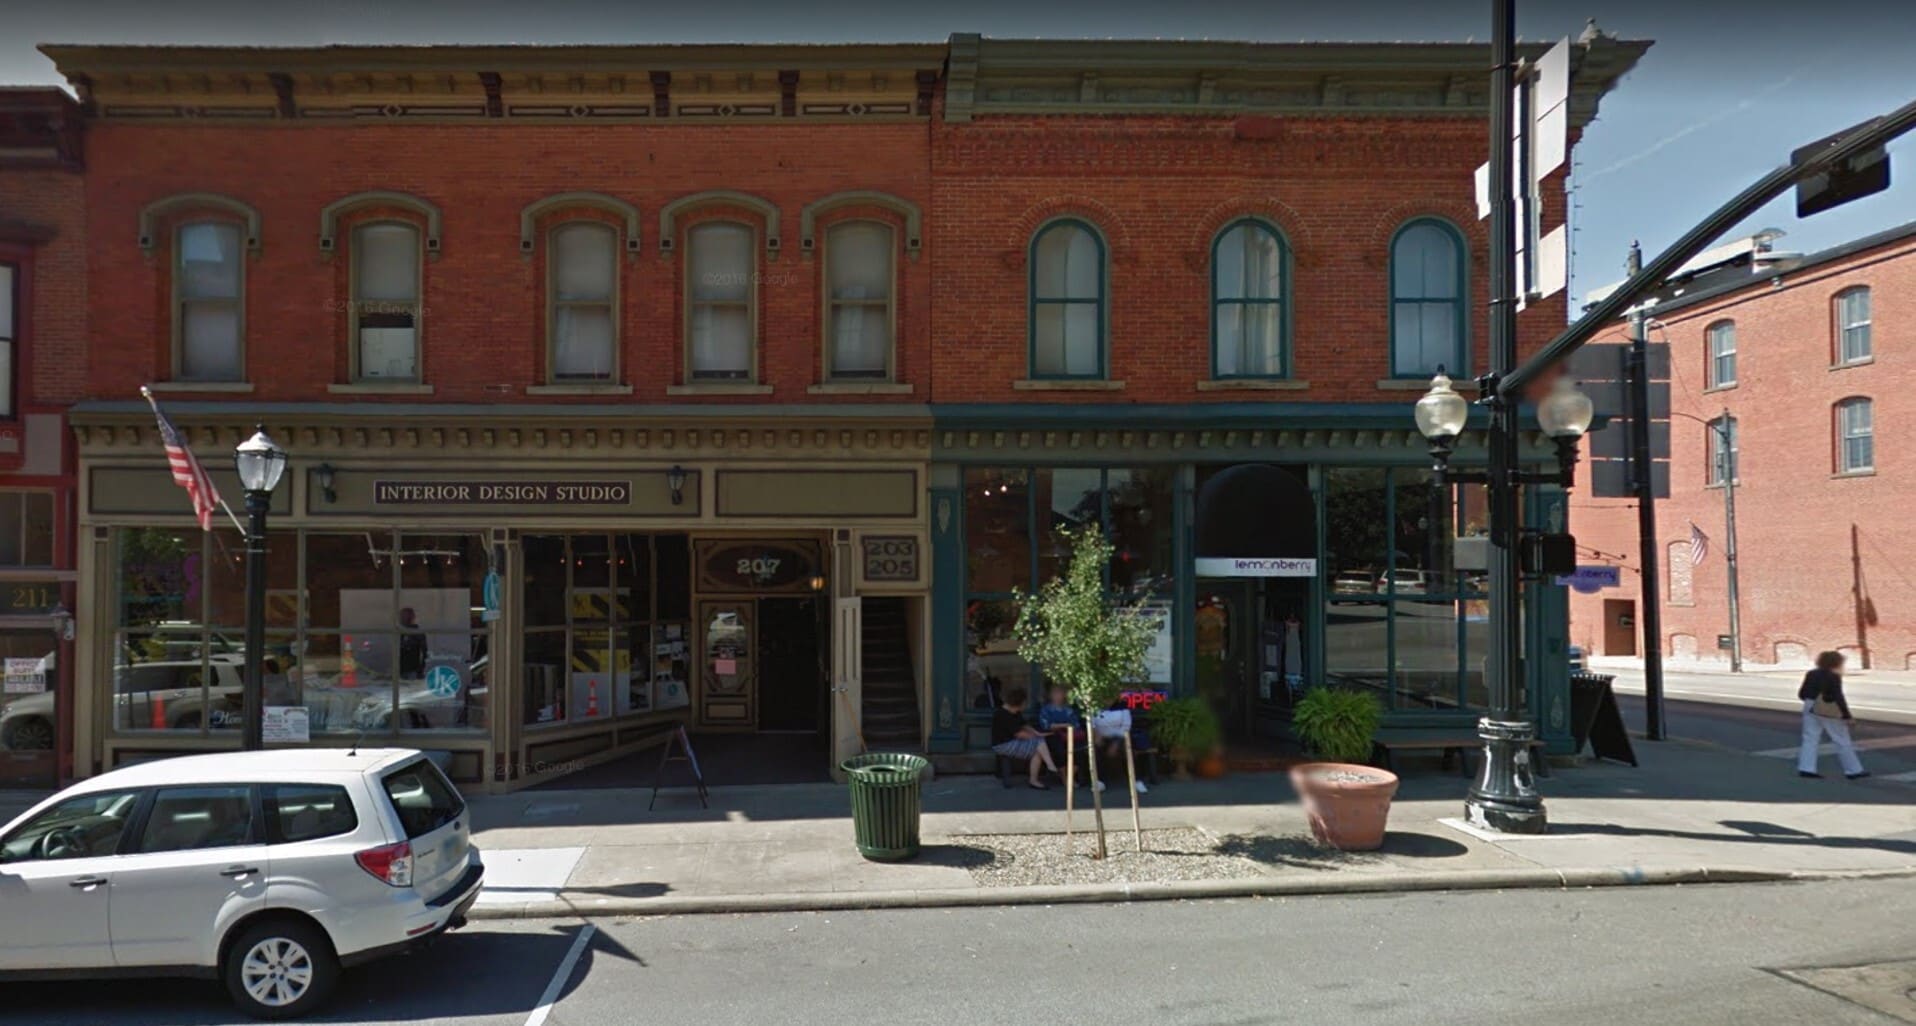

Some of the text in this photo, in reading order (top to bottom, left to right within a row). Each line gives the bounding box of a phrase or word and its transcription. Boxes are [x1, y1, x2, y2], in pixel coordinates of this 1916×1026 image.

[380, 486, 625, 501] INTERIOR DESIGN STUDIO
[868, 542, 912, 556] 203
[737, 558, 782, 575] 207
[869, 560, 913, 575] 205
[1235, 559, 1312, 573] lemonberry
[13, 588, 48, 608] 211
